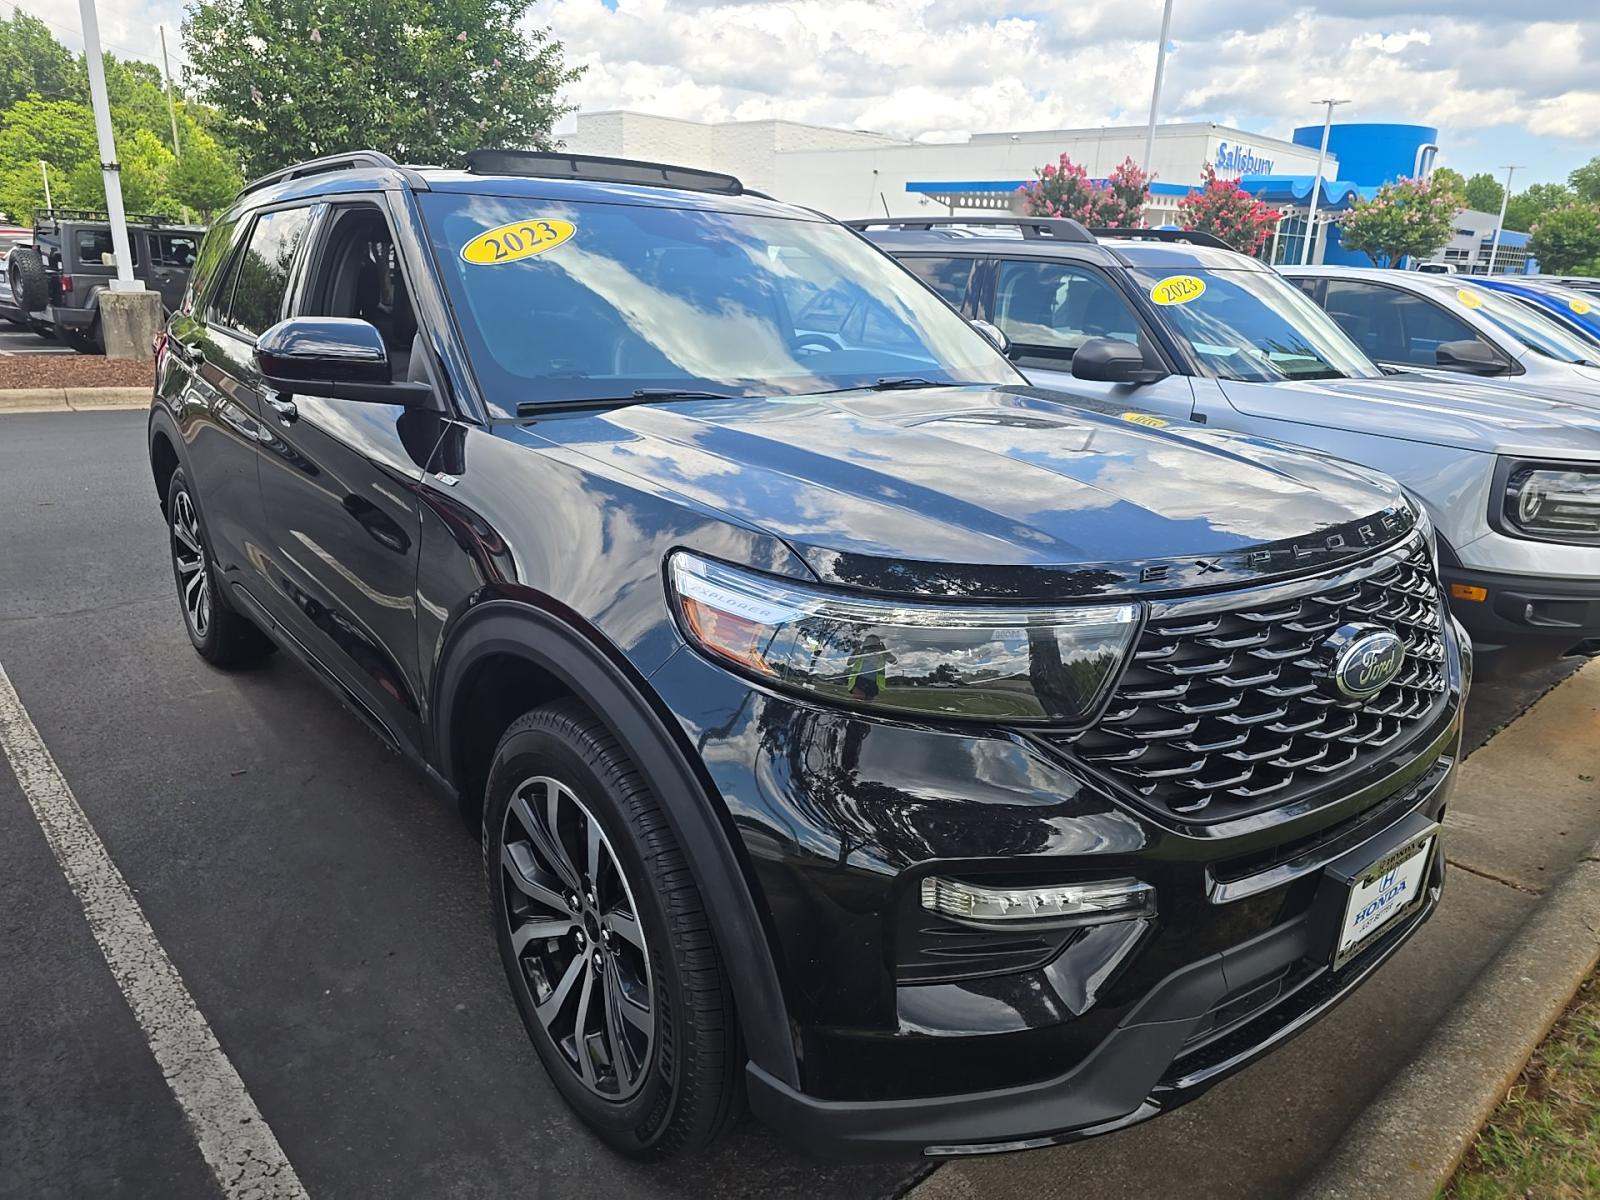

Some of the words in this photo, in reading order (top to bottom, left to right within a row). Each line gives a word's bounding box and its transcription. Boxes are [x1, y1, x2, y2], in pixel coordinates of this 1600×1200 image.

[1215, 142, 1274, 175] Salisbury
[484, 221, 559, 260] 2023
[1161, 278, 1198, 302] 2023
[1360, 649, 1395, 685] Ford
[1353, 880, 1407, 926] HONDA
